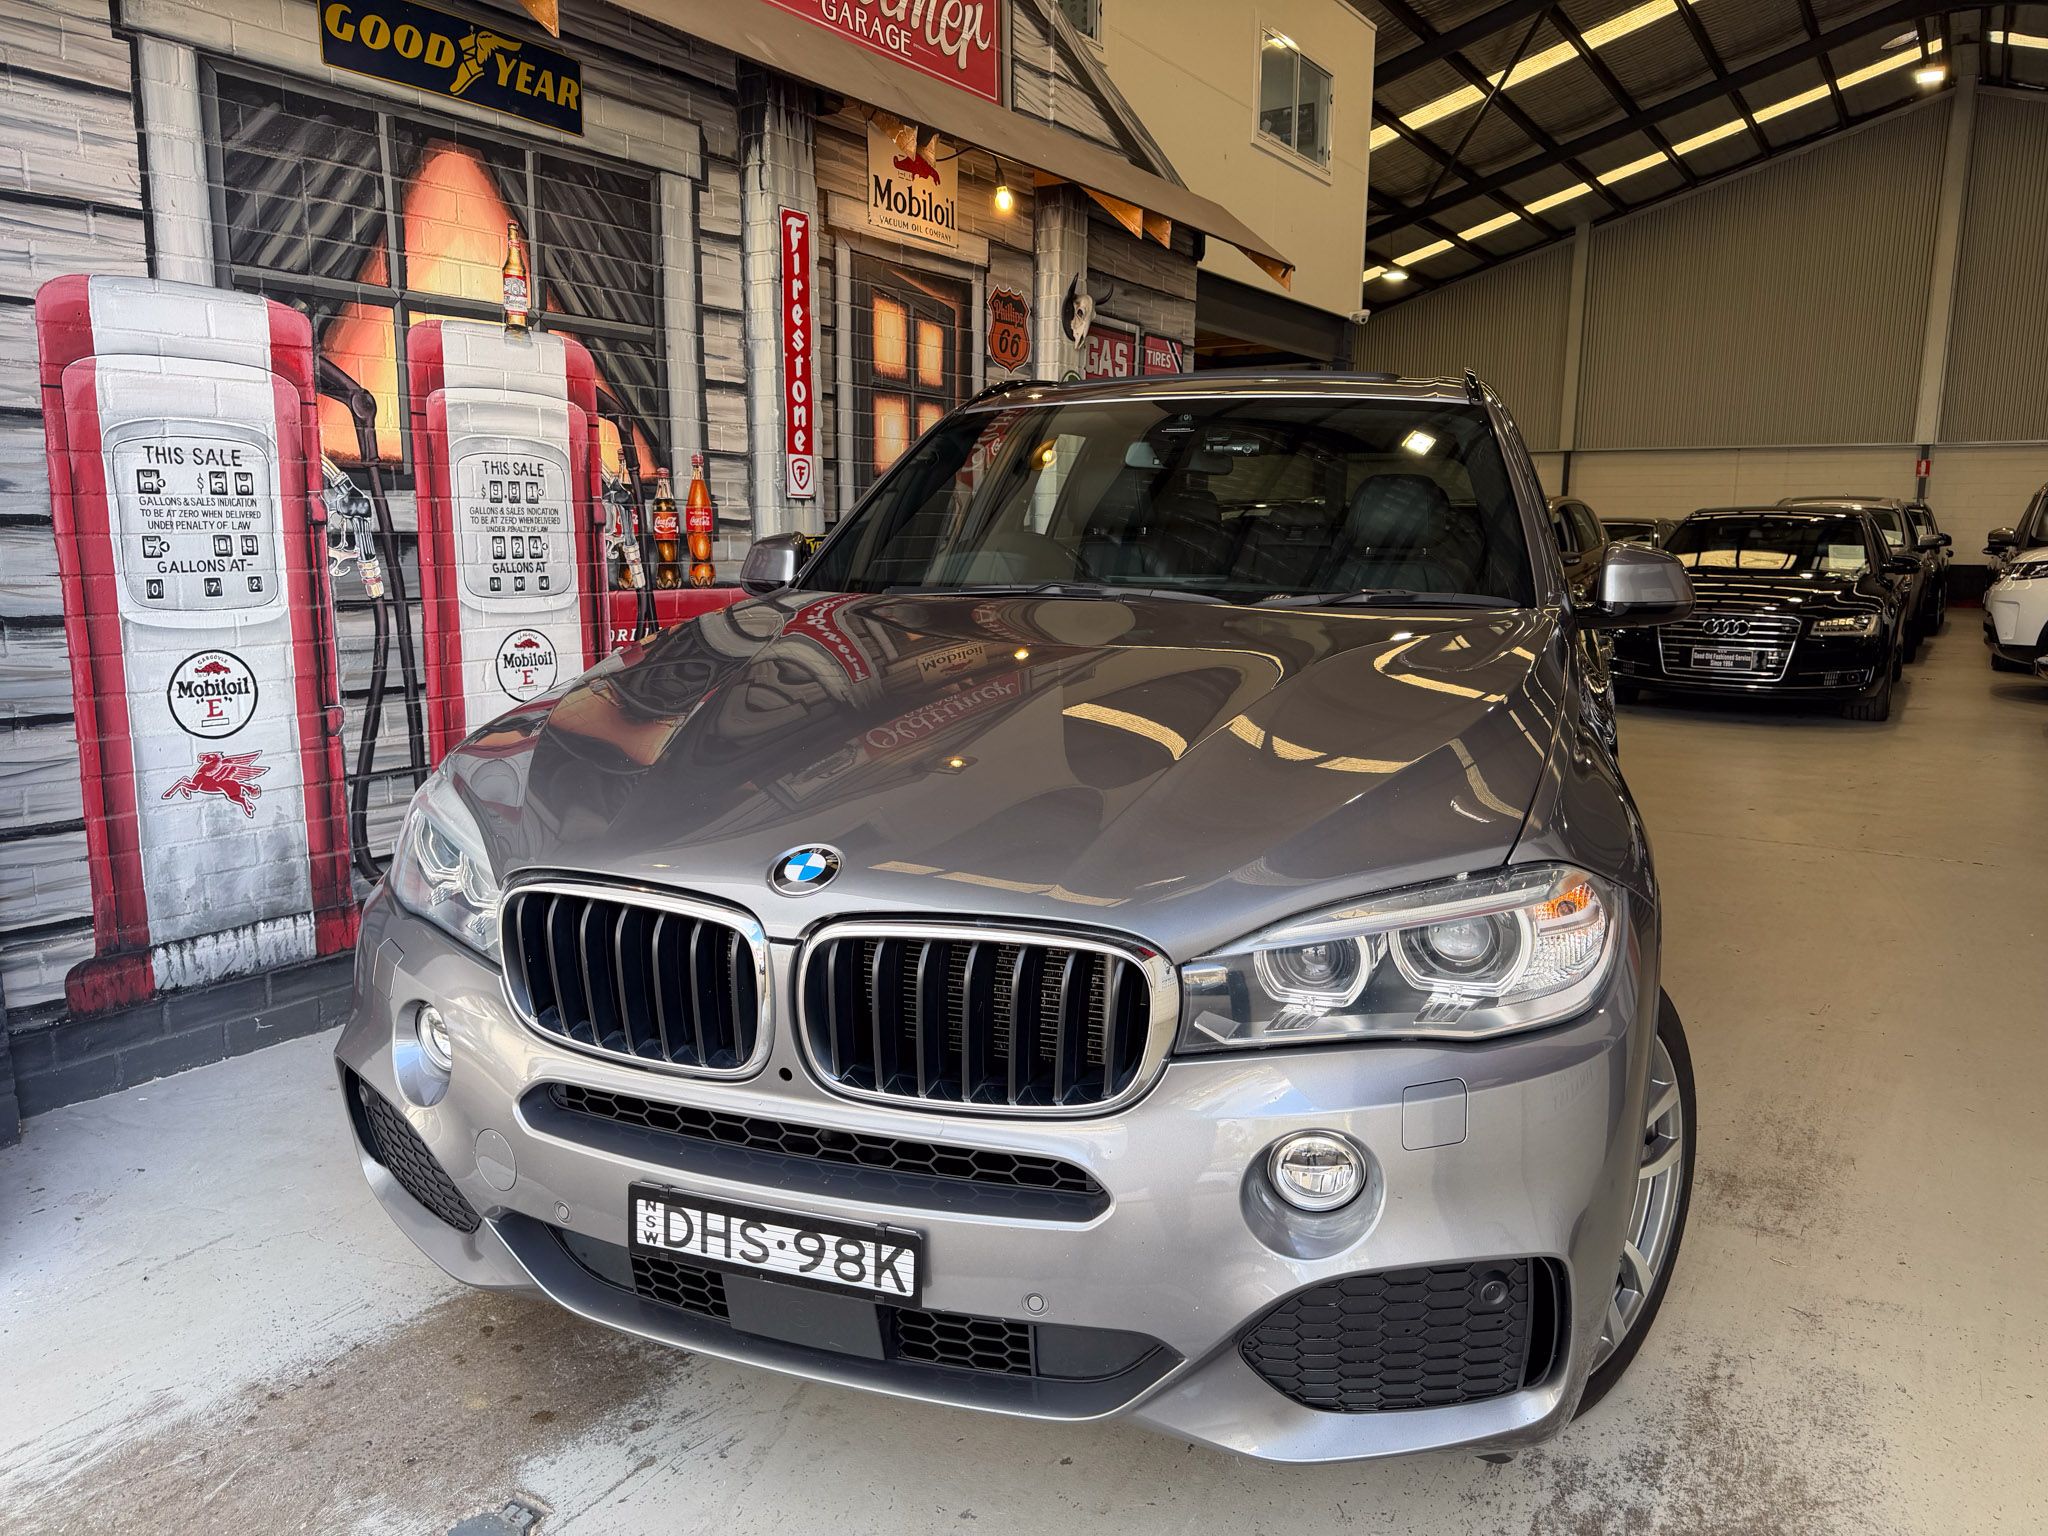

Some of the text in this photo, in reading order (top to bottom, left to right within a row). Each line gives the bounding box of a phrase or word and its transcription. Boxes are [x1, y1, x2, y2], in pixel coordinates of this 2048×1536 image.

[821, 0, 913, 56] GARAGE
[325, 3, 579, 111] GOOD YEAR
[873, 174, 956, 230] Mobiloil
[880, 215, 951, 242] VACUUM OIL COMPANY
[994, 299, 1024, 326] Phillips
[786, 216, 807, 452] Firestone
[999, 329, 1021, 357] 66
[1086, 335, 1128, 377] GAS
[1146, 350, 1171, 368] TIRES
[142, 445, 243, 467] THIS SALE
[482, 460, 544, 477] THIS SALE
[139, 496, 257, 507] GALLONS & SALES INDICATION
[469, 506, 499, 515] GALLONS
[505, 507, 525, 515] SALES
[526, 508, 559, 516] INDICATION
[140, 508, 262, 519] TO BE AT ZERO WHEN DELIVERED
[470, 516, 480, 524] TO
[480, 516, 489, 524] BE
[490, 516, 499, 524] AT
[500, 516, 517, 524] ZERO
[534, 517, 561, 525] DELIVERED
[147, 521, 251, 530] UNDER PENALTY OF LAW
[157, 559, 226, 573] GALLONS
[492, 561, 548, 574] GALLONS AT
[503, 651, 553, 669] Mobiloil
[176, 676, 250, 698] Mobiloil
